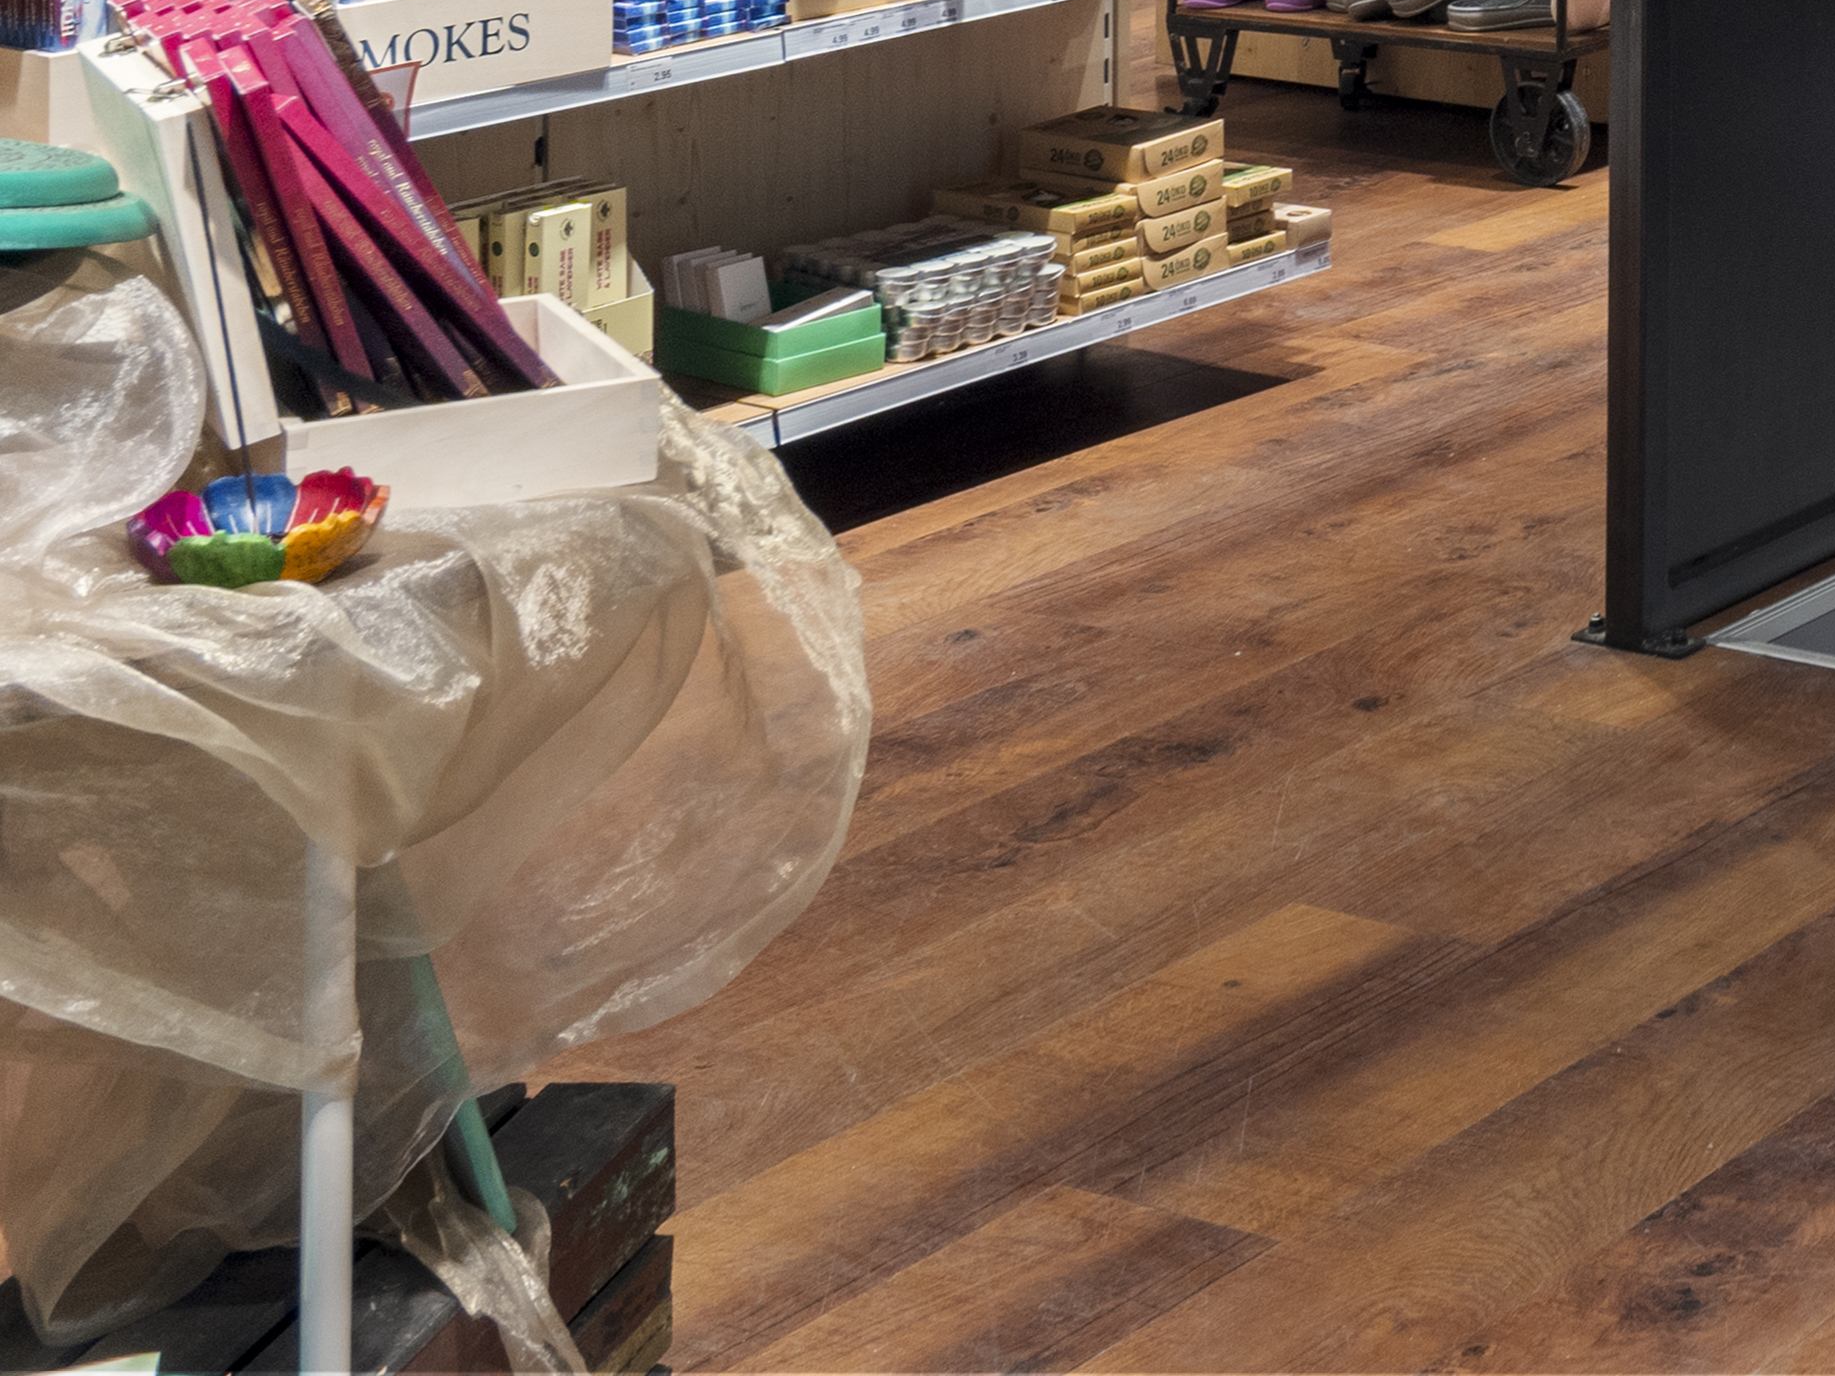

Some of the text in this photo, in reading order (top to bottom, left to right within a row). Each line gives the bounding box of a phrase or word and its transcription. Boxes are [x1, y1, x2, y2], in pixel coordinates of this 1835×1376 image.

[360, 13, 531, 69] MOKES
[1161, 149, 1174, 167] 24
[1156, 190, 1170, 206] 24
[1163, 225, 1176, 241] 24
